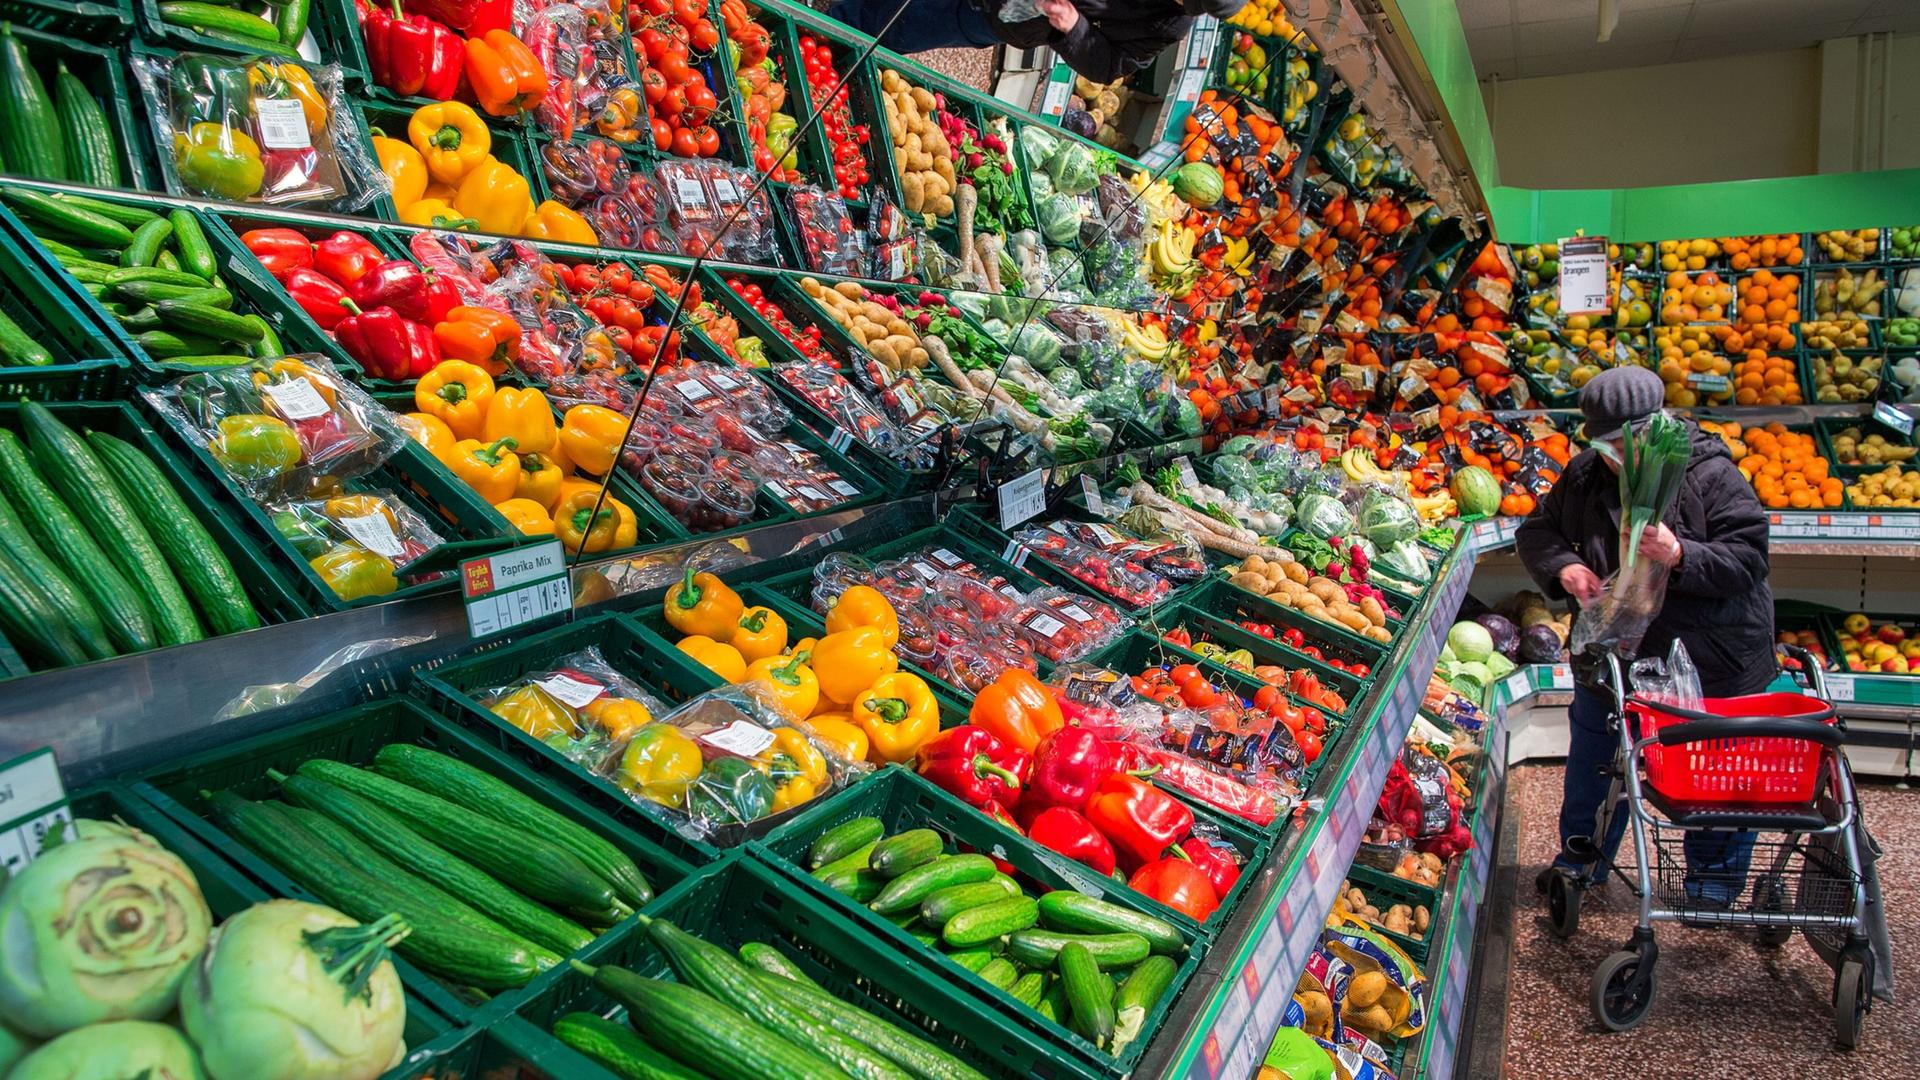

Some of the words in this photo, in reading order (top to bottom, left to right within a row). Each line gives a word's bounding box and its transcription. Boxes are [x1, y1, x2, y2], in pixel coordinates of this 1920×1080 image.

[467, 564, 489, 579] Täglich
[501, 560, 534, 577] Paprika
[535, 555, 552, 569] Mix
[472, 578, 489, 591] frisch
